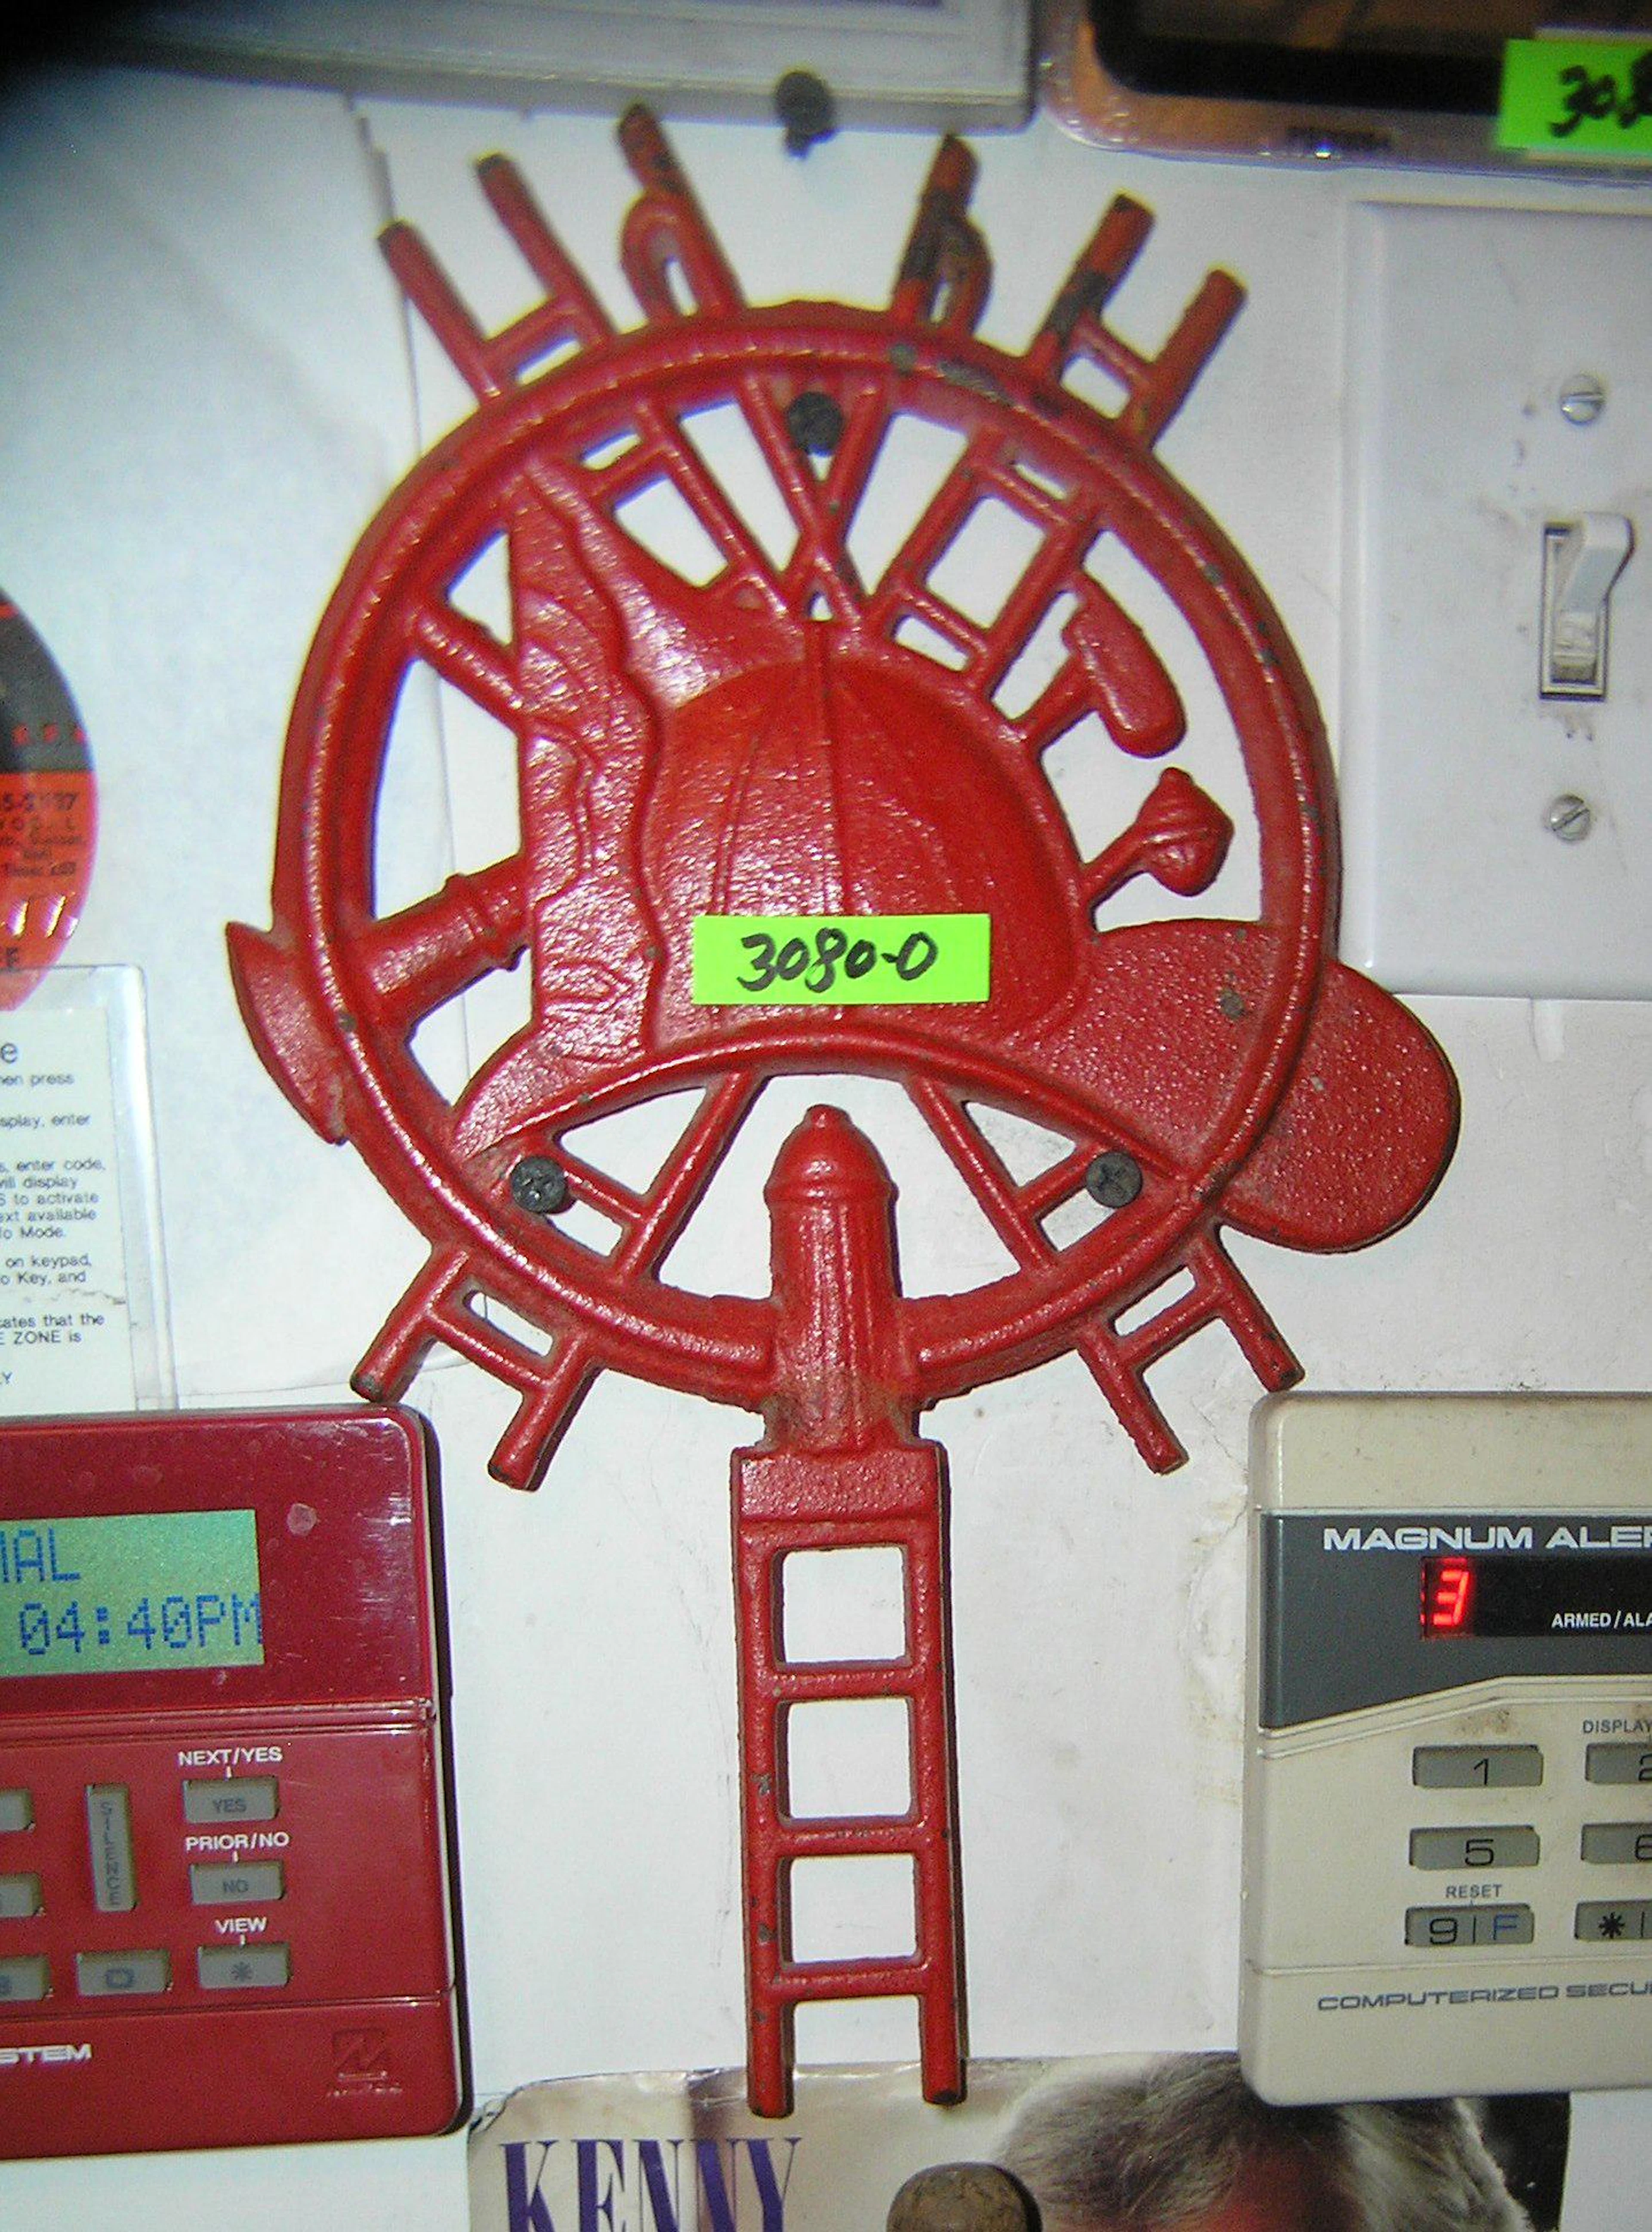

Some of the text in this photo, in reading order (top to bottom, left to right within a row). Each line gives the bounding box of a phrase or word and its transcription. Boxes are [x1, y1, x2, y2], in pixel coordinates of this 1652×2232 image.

[737, 927, 939, 993] 3080-0
[30, 1074, 75, 1087] press
[51, 1113, 91, 1126] enter
[16, 1160, 55, 1171] enter
[23, 1175, 78, 1190] display
[14, 1194, 29, 1205] to
[37, 1193, 99, 1205] activate
[28, 1207, 97, 1222] available
[5, 1258, 24, 1268] on
[58, 1271, 87, 1283] and
[44, 1313, 73, 1327] that
[80, 1312, 105, 1326] the
[14, 1329, 61, 1344] ZONE
[68, 1332, 83, 1343] is
[1324, 1526, 1533, 1550] MAGNUM
[19, 1592, 262, 1655] 04:40PM
[178, 1746, 283, 1766] NEXT/YES
[1474, 1757, 1489, 1786] 1
[213, 1797, 247, 1813] YES
[185, 1831, 290, 1851] PRIOR/NO
[1464, 1838, 1495, 1867] 5
[222, 1878, 249, 1893] NO
[1445, 1884, 1502, 1898] RESET
[214, 1916, 268, 1933] VIEW
[1429, 1913, 1519, 1945] 9 F
[1318, 1981, 1652, 2011] COMPUTERIZED SECU
